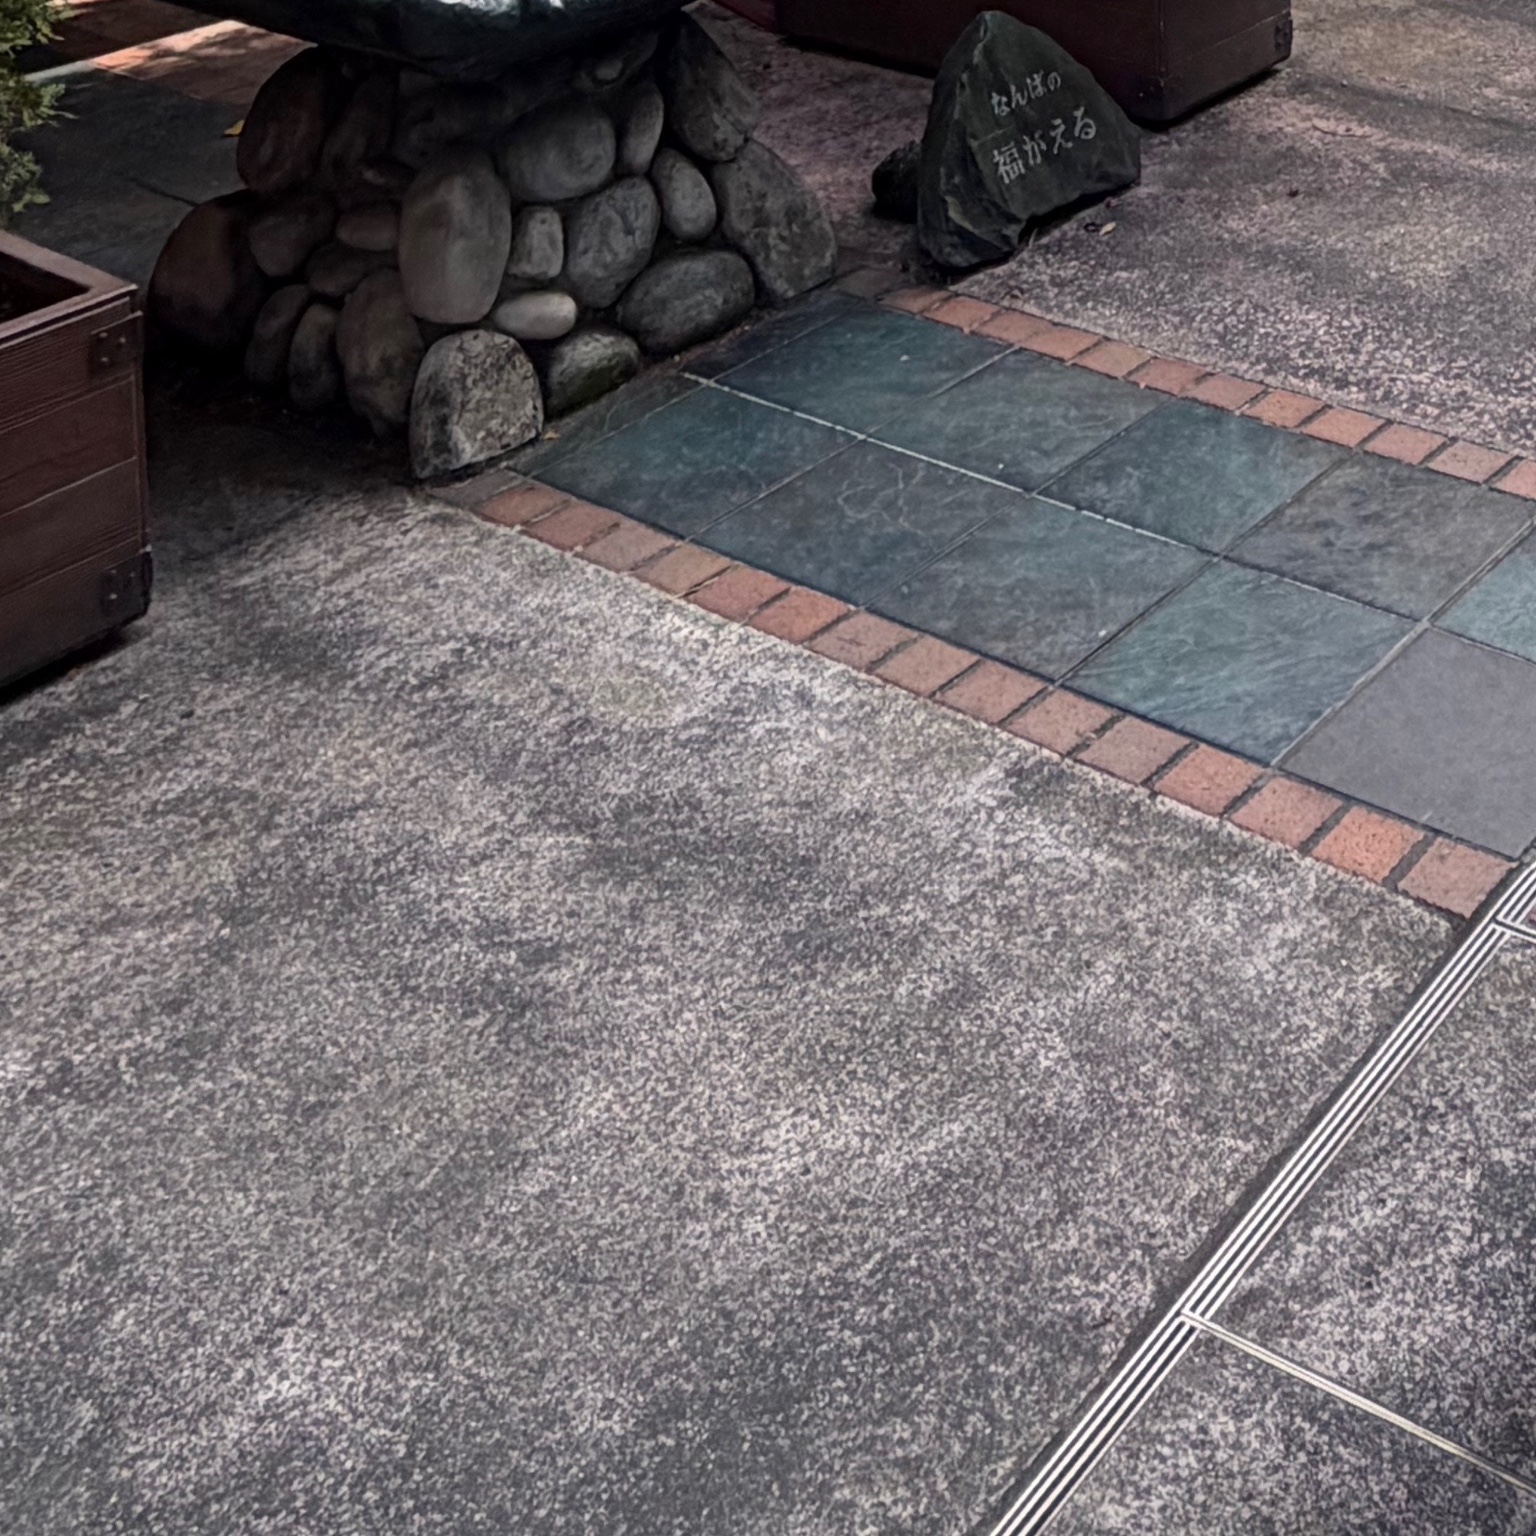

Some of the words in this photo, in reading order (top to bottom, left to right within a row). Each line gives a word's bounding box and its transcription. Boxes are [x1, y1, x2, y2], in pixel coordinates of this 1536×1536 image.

[991, 69, 1061, 117] なんばの
[992, 106, 1096, 184] 福がえる
